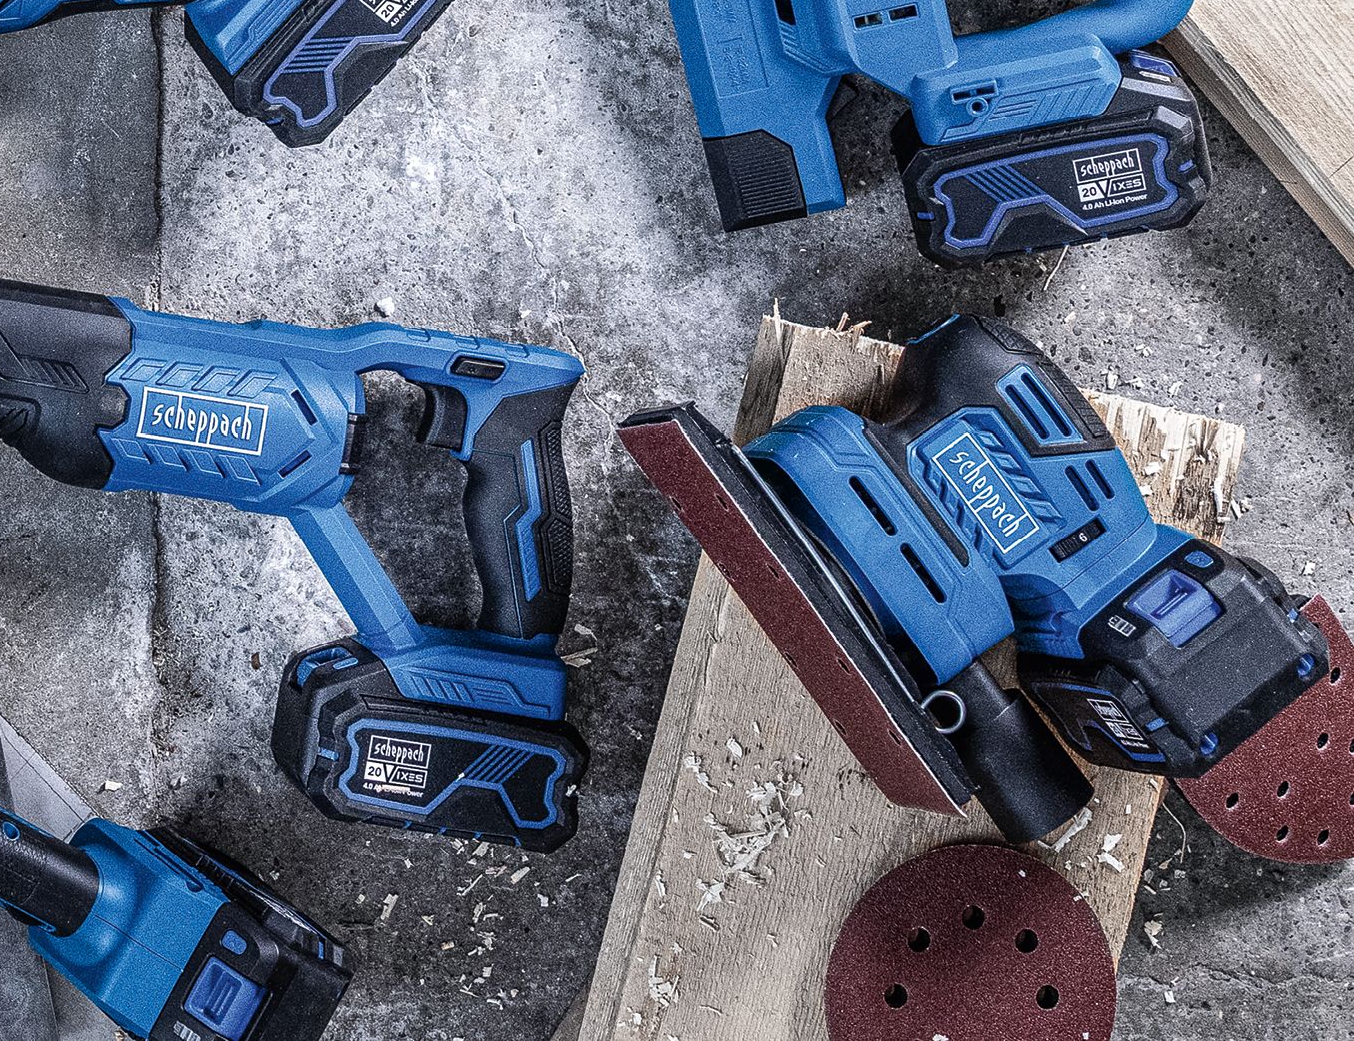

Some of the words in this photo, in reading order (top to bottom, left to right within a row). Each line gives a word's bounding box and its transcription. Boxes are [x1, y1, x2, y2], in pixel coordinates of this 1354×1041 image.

[1080, 151, 1134, 177] scheppach
[1125, 194, 1148, 203] Power
[152, 395, 252, 444] scheppach
[949, 451, 1029, 538] scheppach
[1079, 532, 1088, 542] 6
[374, 739, 424, 764] scheppach
